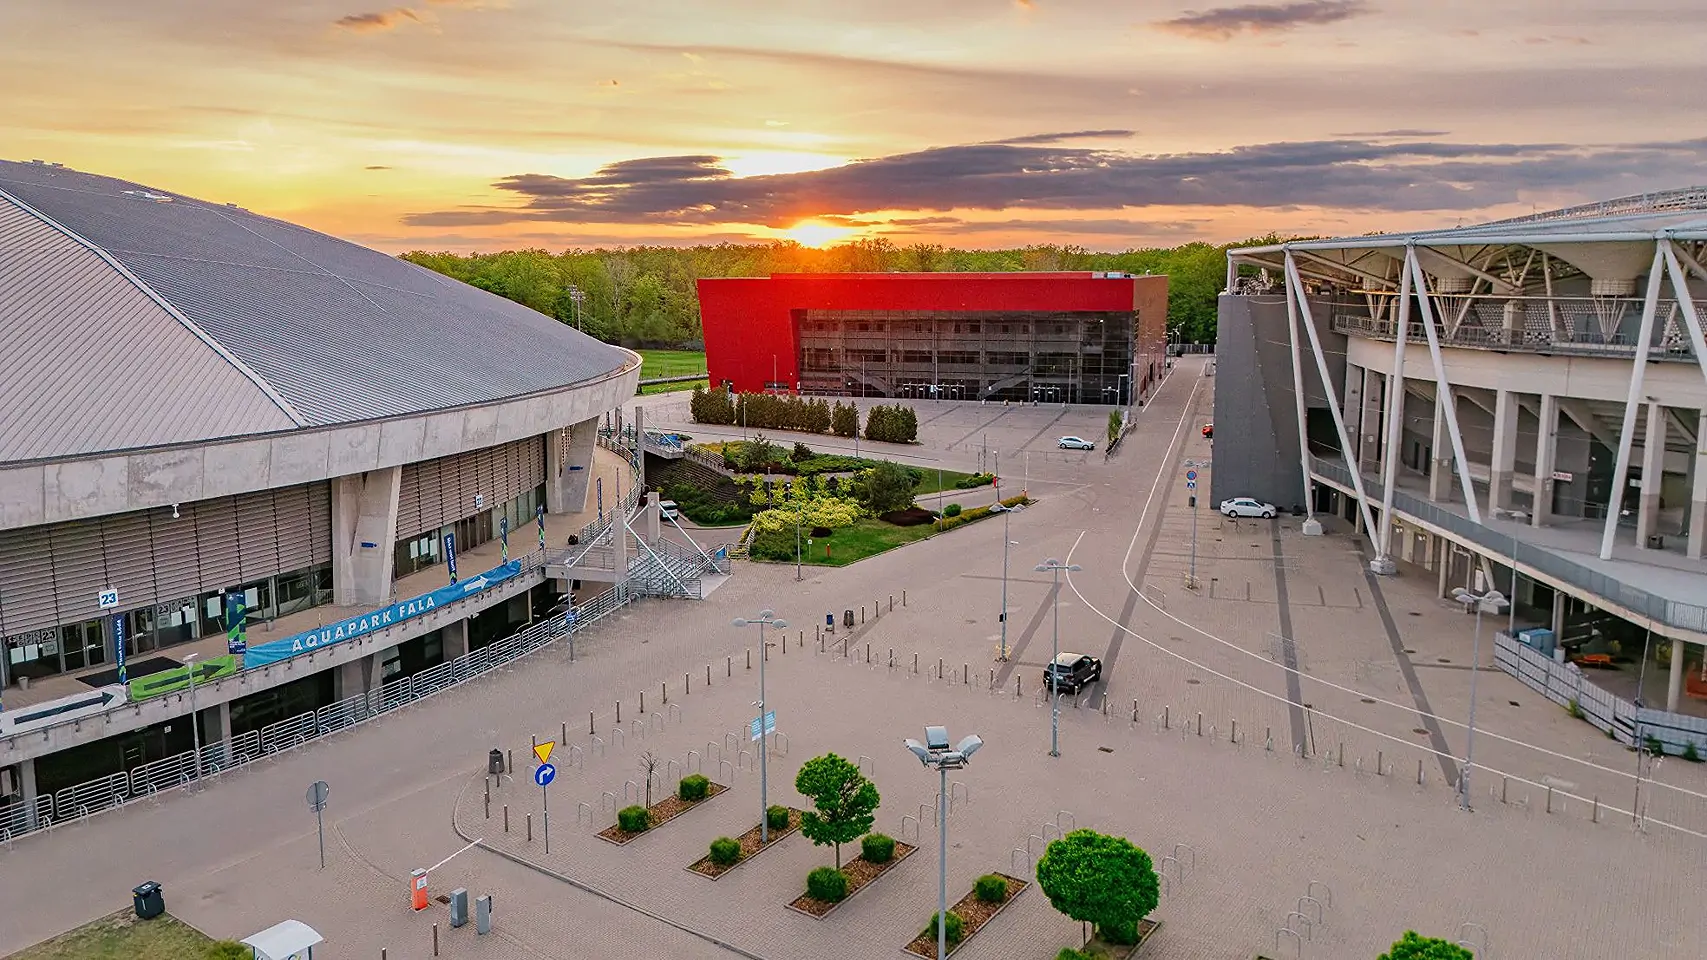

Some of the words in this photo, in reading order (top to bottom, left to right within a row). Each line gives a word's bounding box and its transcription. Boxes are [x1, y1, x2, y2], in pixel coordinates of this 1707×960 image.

[101, 593, 117, 606] 23
[291, 610, 392, 653] AQUAPARK
[399, 596, 435, 617] FALA
[42, 630, 56, 641] 23
